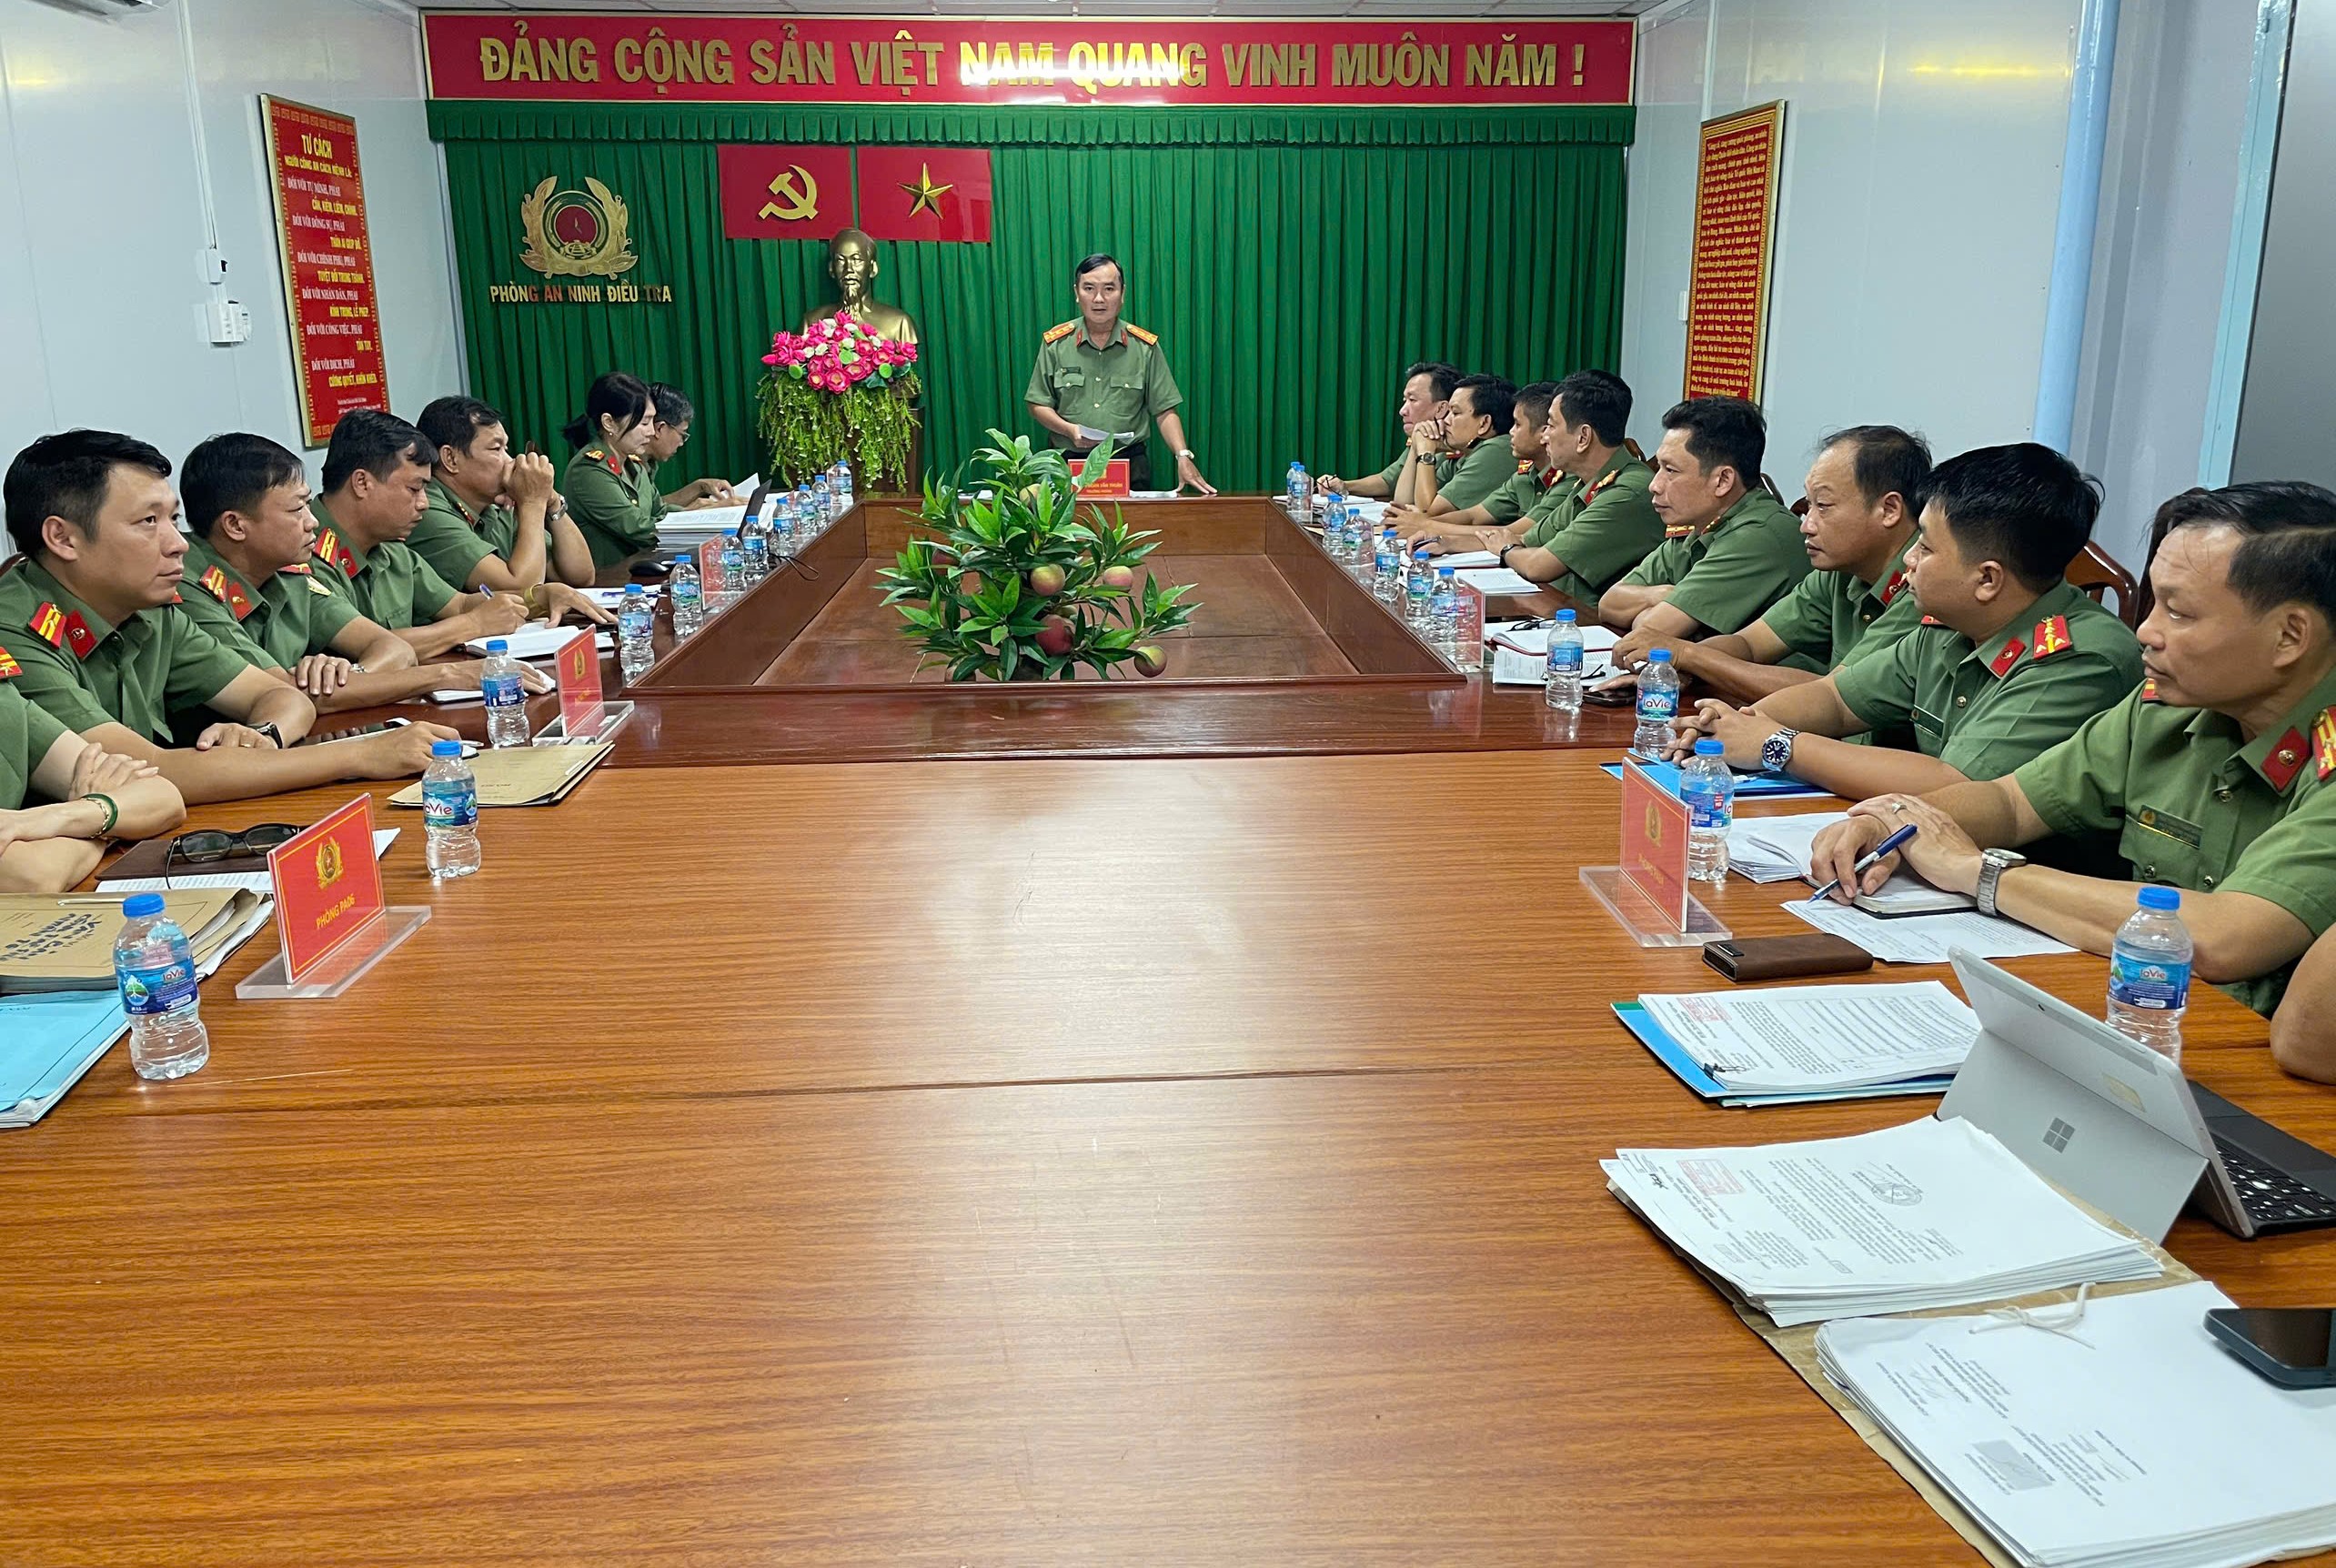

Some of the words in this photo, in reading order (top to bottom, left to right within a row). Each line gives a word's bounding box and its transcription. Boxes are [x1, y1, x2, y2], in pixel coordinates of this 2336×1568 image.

[480, 20, 599, 83] ĐẢNG
[615, 27, 735, 94] CỘNG
[750, 23, 836, 85] SẢN
[852, 30, 943, 95] VIỆT
[959, 42, 1053, 87] NAM
[1070, 42, 1207, 95] QUANG
[1223, 43, 1316, 87] VINH
[1332, 32, 1449, 88] MUÔN
[1465, 32, 1556, 87] NĂM
[313, 134, 332, 159] CÁCH
[489, 280, 539, 303] PHÒNG
[544, 286, 563, 303] AN
[568, 286, 600, 303] NINH
[607, 279, 638, 303] ĐIỀU
[644, 286, 672, 303] TRA
[1644, 698, 1670, 708] laVie
[425, 803, 452, 815] aVie
[316, 905, 340, 930] PHÒNG
[339, 893, 356, 913] PA06
